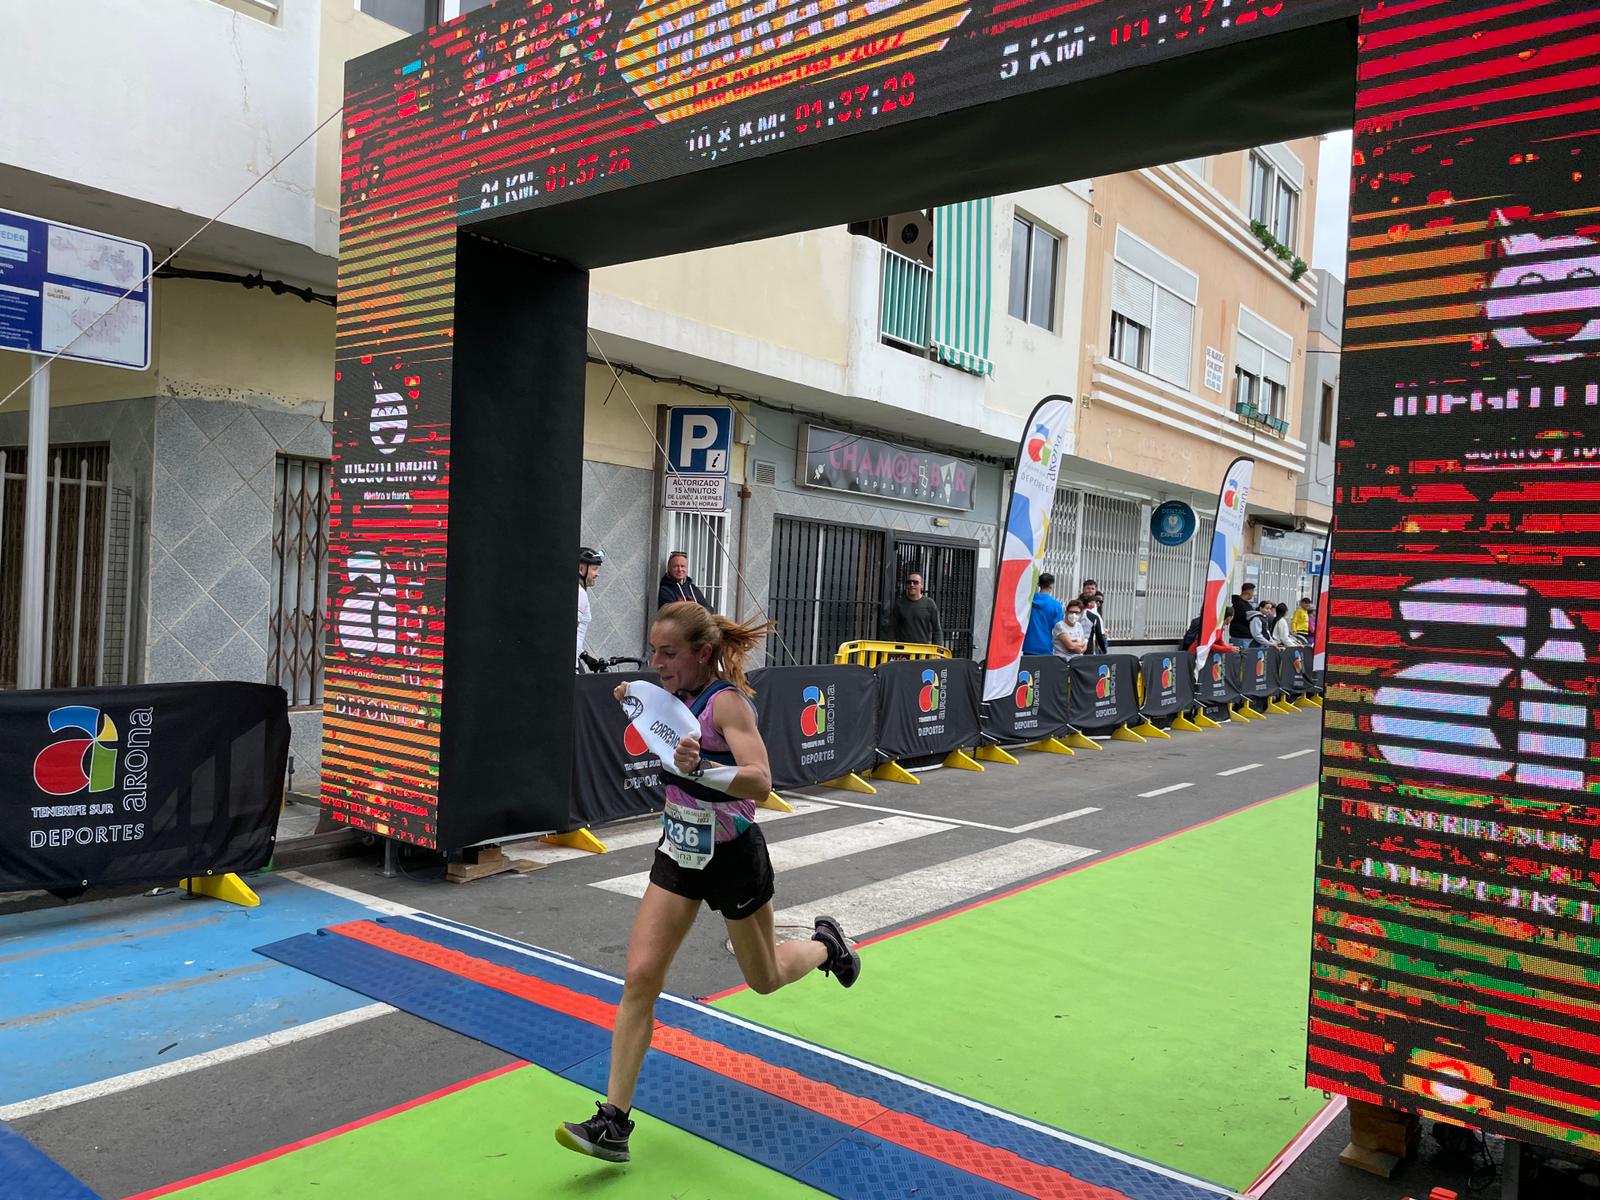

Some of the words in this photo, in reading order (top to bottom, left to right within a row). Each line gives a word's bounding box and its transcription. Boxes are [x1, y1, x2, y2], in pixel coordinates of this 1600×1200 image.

[999, 43, 1020, 80] 5
[680, 414, 718, 468] P
[672, 479, 720, 488] AUTORIZADO
[930, 461, 967, 494] BAR
[684, 487, 717, 495] MINUTOS
[1311, 551, 1324, 573] P
[826, 684, 835, 744] arona
[918, 725, 945, 737] DEPORTES
[122, 706, 154, 812] arona
[801, 749, 835, 766] DEPORTES
[623, 774, 662, 790] DEPOR
[31, 805, 87, 818] TENERIFE
[89, 803, 114, 815] SUR
[30, 823, 145, 848] DEPORTES
[667, 819, 700, 848] 236
